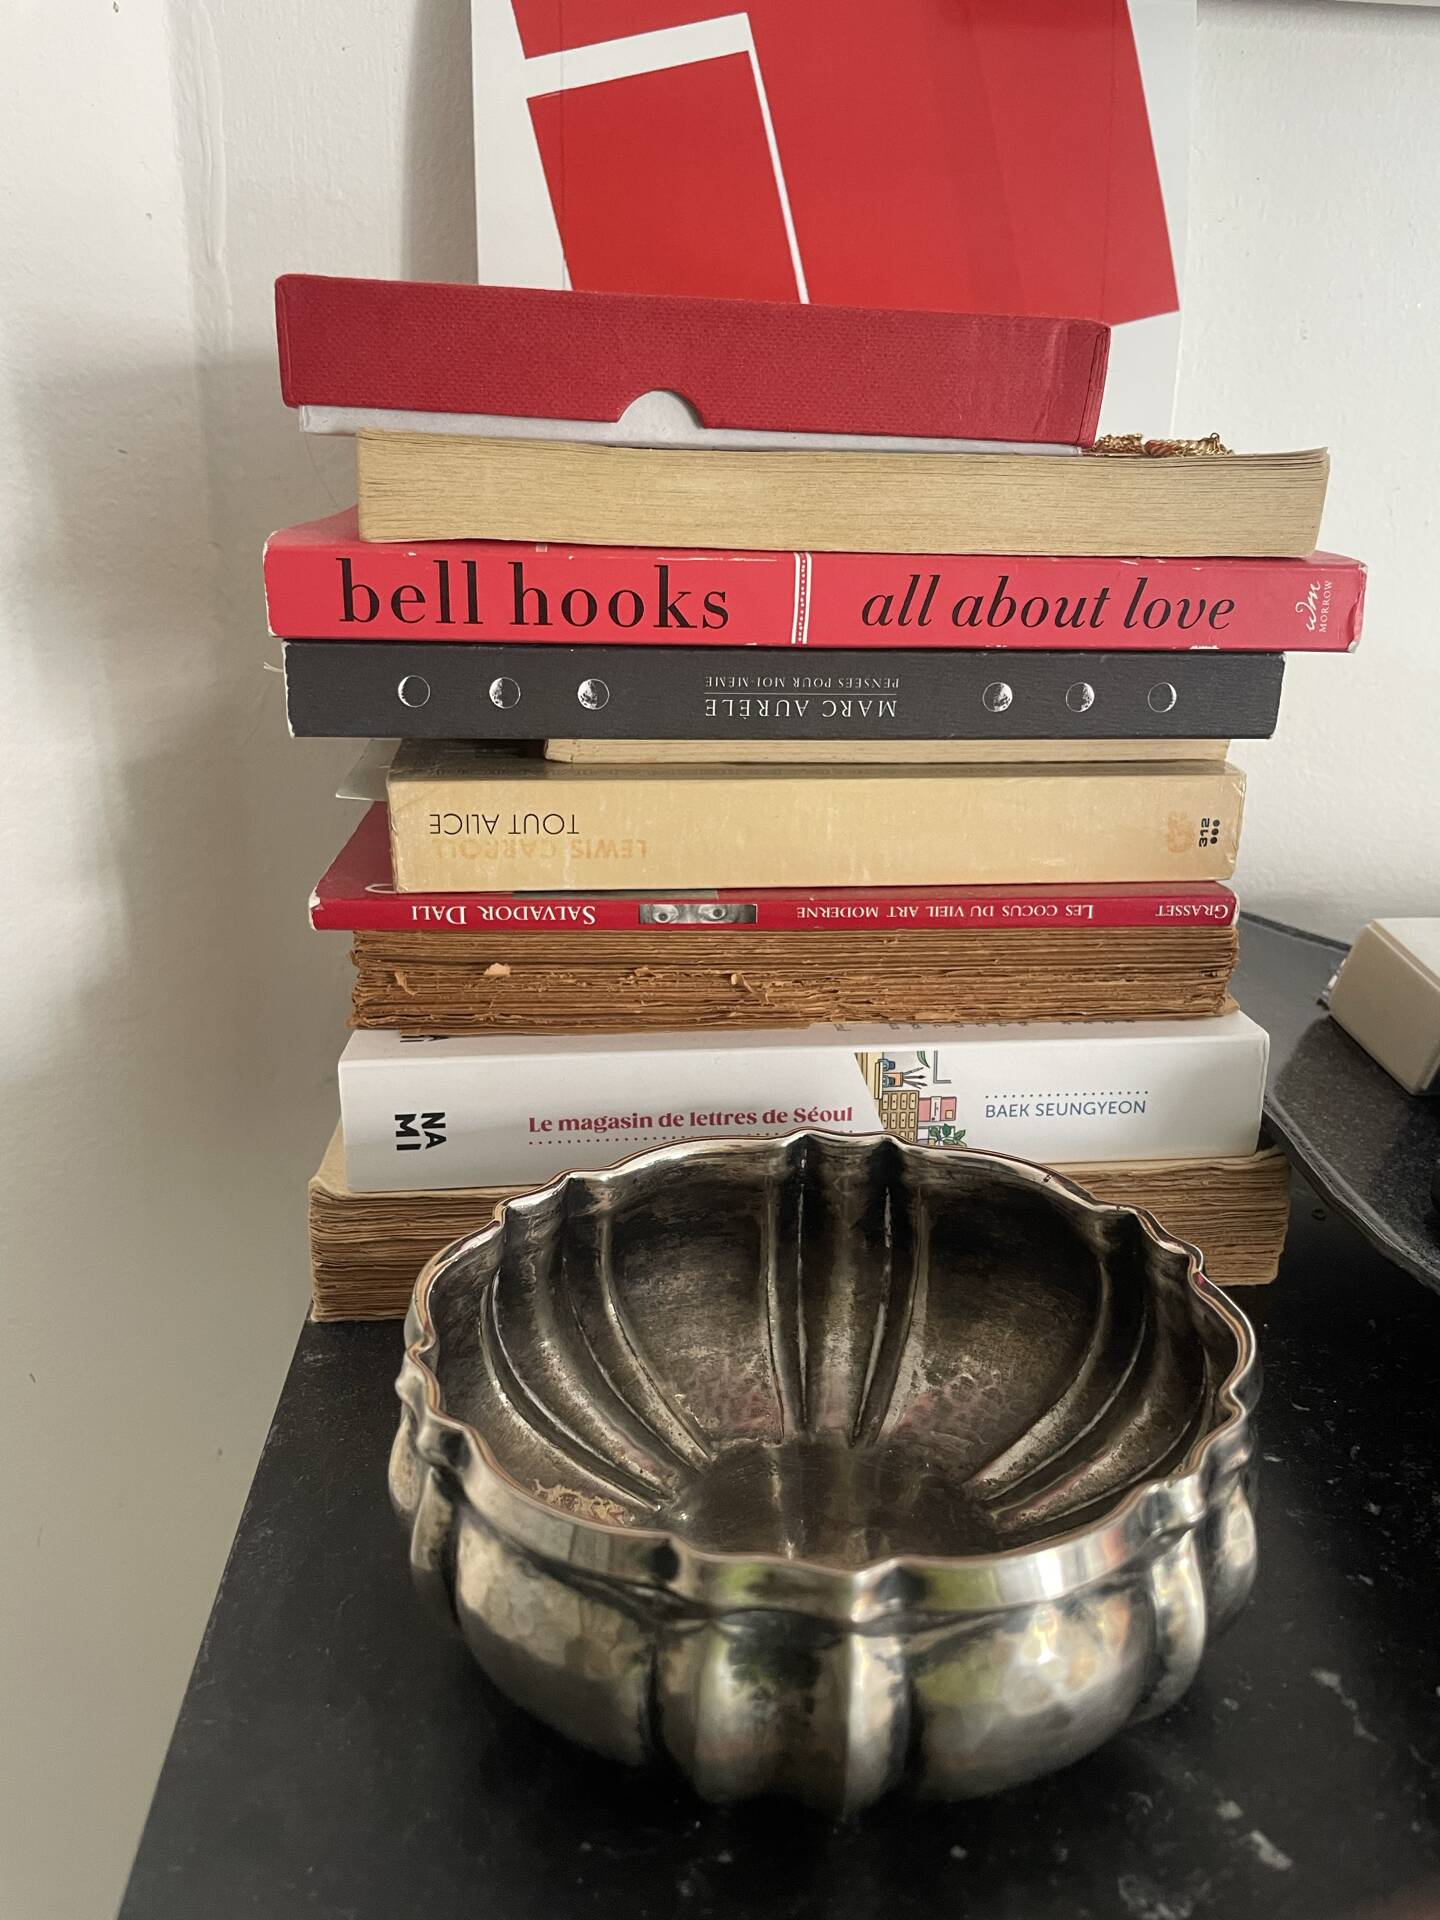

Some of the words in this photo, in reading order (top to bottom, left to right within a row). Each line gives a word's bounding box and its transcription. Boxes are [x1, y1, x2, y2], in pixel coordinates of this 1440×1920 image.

[336, 557, 485, 625] bell
[507, 561, 730, 630] hooks
[861, 574, 941, 628] all
[951, 575, 1110, 630] about
[1123, 577, 1236, 630] love
[1319, 580, 1332, 633] MORROW
[792, 677, 832, 689] POUR
[705, 698, 809, 720] AURÈLE
[821, 700, 897, 718] MARC
[429, 813, 500, 836] ALICE
[507, 813, 580, 836] TOUT
[1198, 817, 1210, 848] 312
[431, 838, 557, 860] CARROLL
[570, 839, 649, 860] LEWIS
[411, 905, 468, 925] DALI
[476, 905, 596, 925] SALVADOR
[796, 906, 879, 919] MODERNE
[886, 905, 919, 919] ART
[928, 905, 965, 919] VIEIL
[969, 905, 994, 919] DU
[1002, 905, 1058, 919] COCUS
[1065, 903, 1094, 920] LES
[1155, 904, 1229, 920] GRASSET
[985, 1102, 1030, 1119] BAEK
[1035, 1099, 1147, 1118] SEUNGYEON
[528, 1115, 553, 1134] Le
[558, 1111, 654, 1137] magasin
[658, 1110, 685, 1129] de
[689, 1109, 757, 1128] lettres
[762, 1107, 789, 1125] de
[793, 1105, 854, 1124] Séoul
